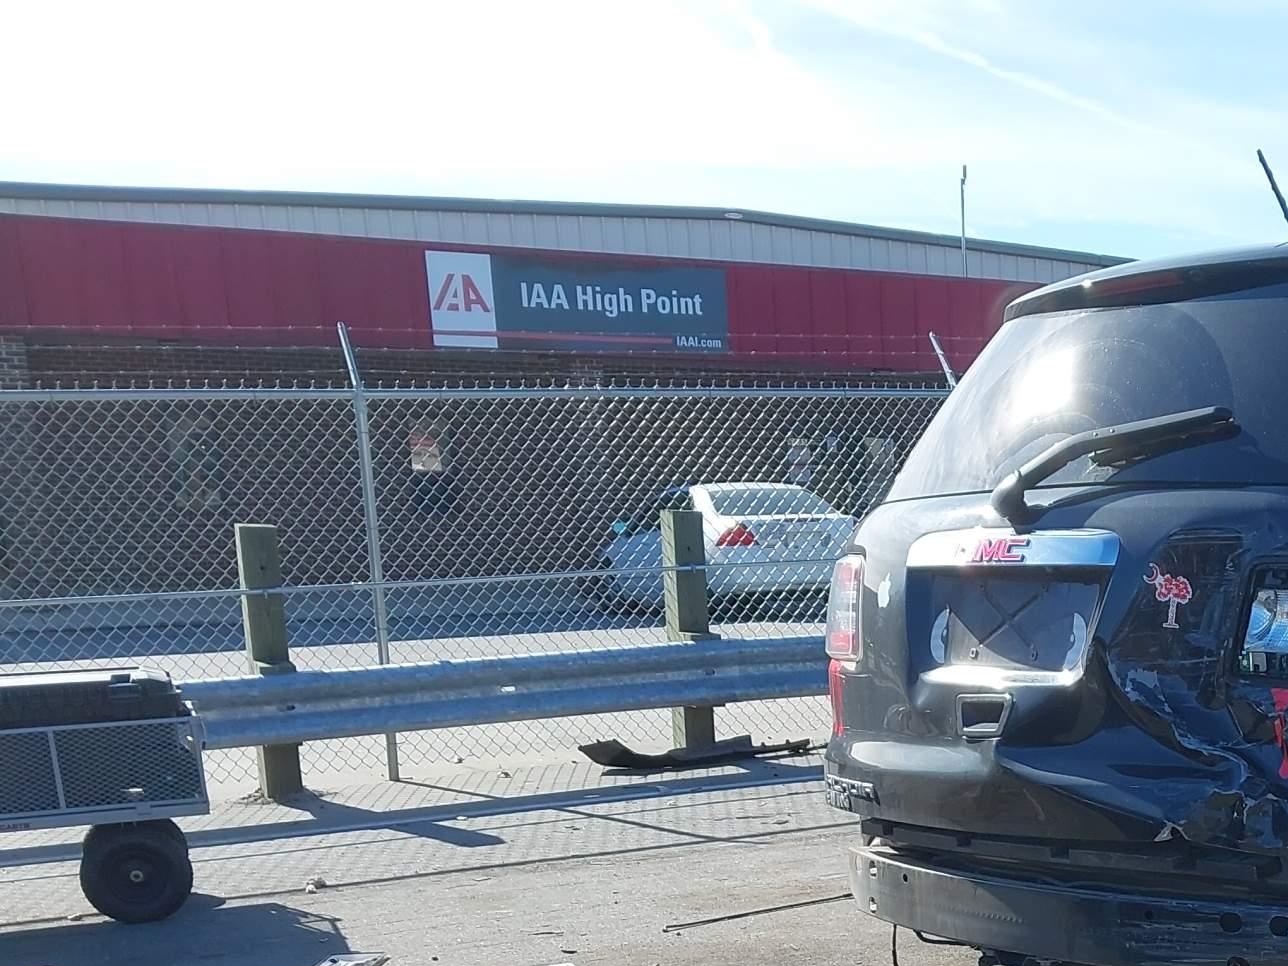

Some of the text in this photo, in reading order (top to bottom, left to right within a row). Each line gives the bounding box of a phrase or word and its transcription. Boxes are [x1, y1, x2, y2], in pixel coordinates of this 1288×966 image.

[520, 282, 703, 317] IAA High Point
[676, 335, 722, 348] IAAI.com
